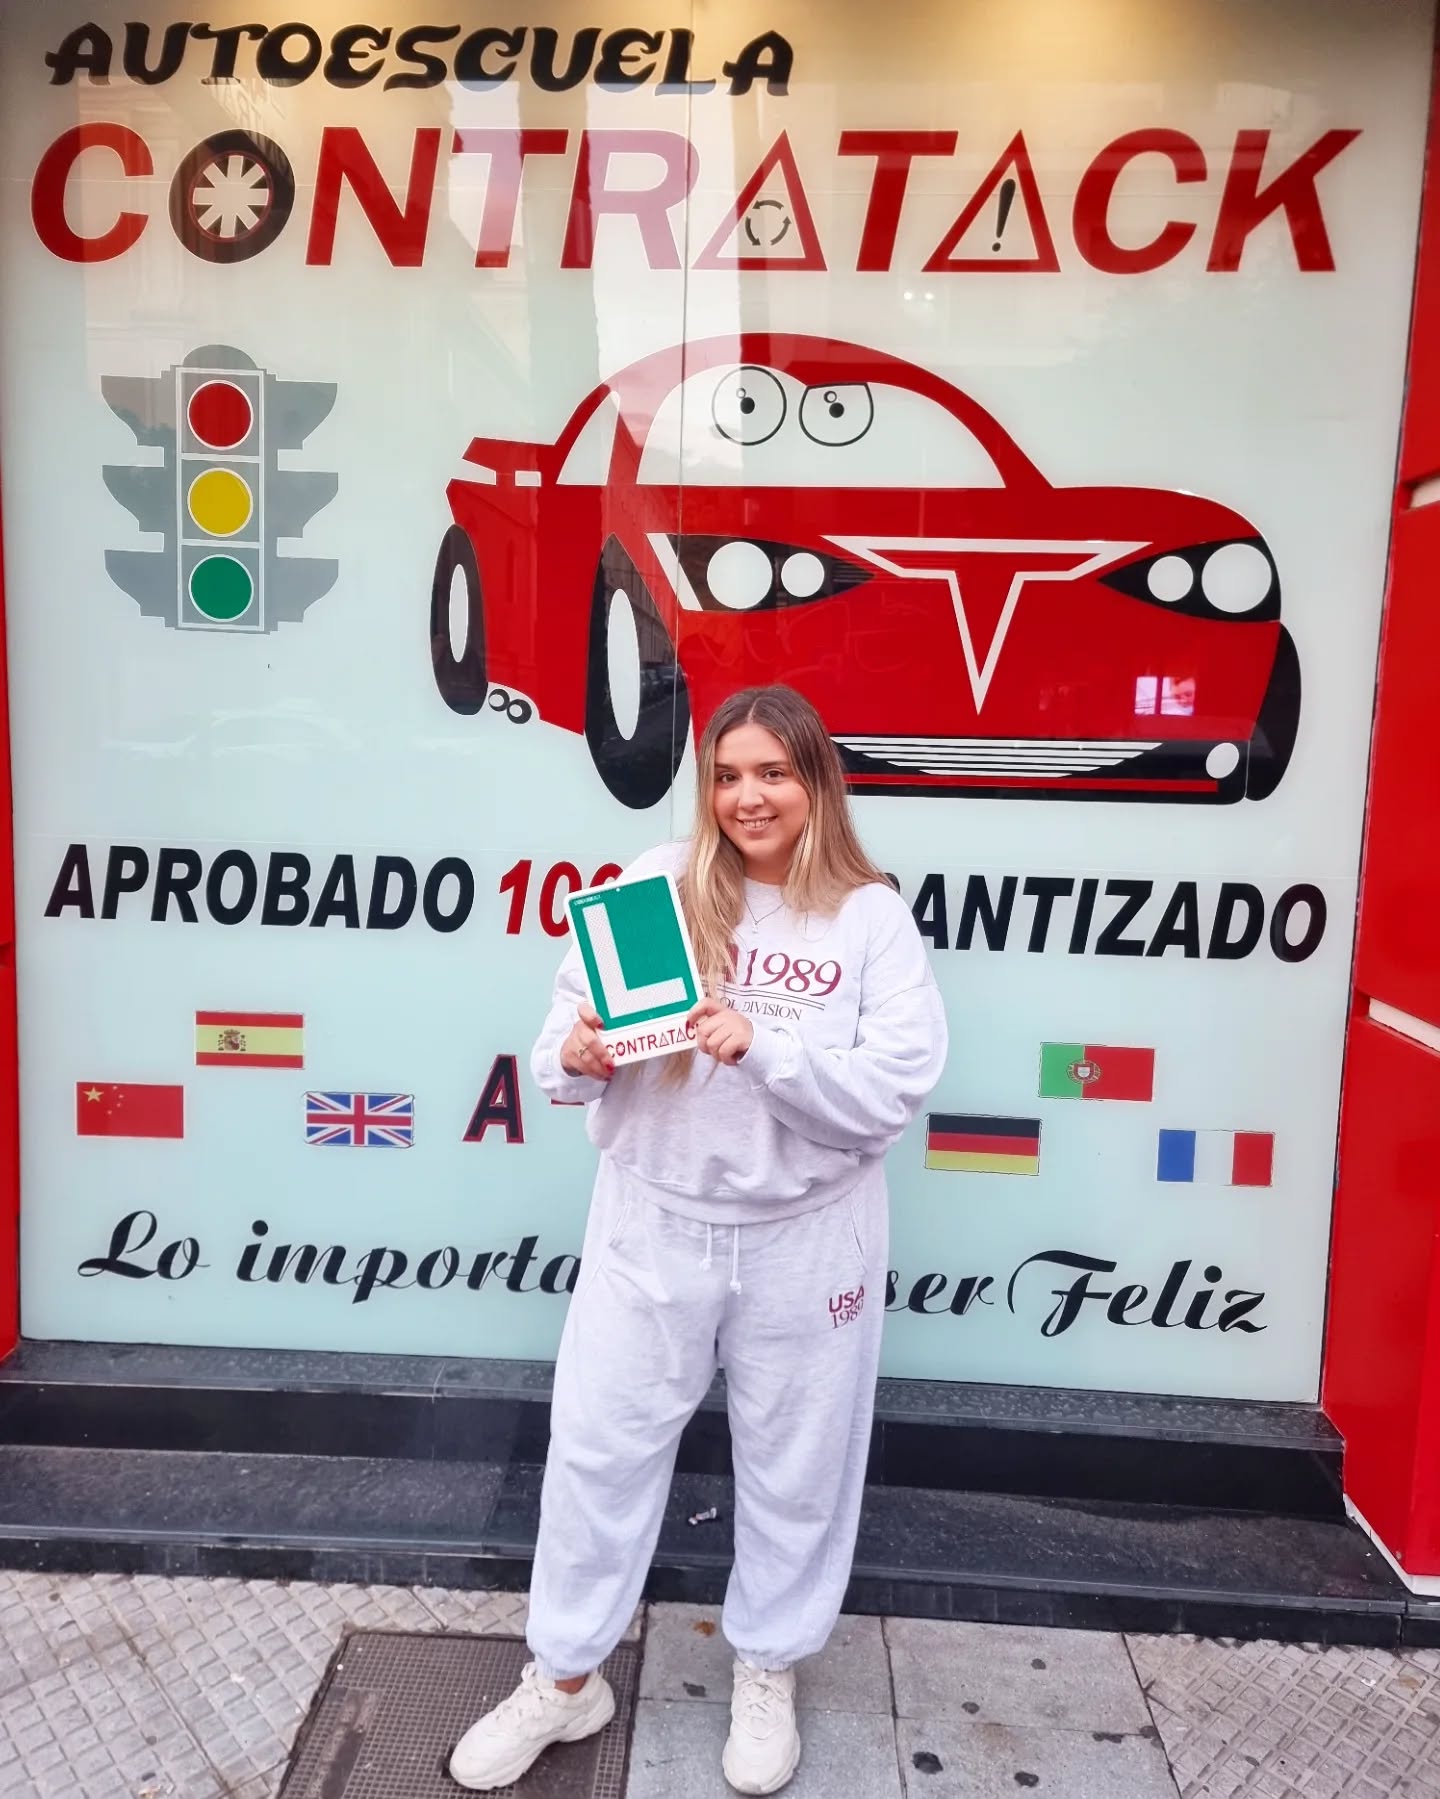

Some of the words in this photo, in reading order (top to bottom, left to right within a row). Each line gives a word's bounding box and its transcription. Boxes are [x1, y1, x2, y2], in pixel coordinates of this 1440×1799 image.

[45, 22, 794, 96] AUTOESCUELA
[31, 122, 1364, 274] CONTRATACK
[44, 844, 474, 933] APROBADO
[883, 872, 1327, 963] ANTIZADO
[582, 902, 689, 1019] L
[740, 948, 842, 997] 1989
[605, 1022, 698, 1058] CONTRATAC
[742, 1000, 802, 1021] DIVISION
[462, 1054, 525, 1144] A
[77, 1210, 210, 1280] Lo
[1007, 1250, 1268, 1337] Feliz
[829, 1285, 865, 1313] USA
